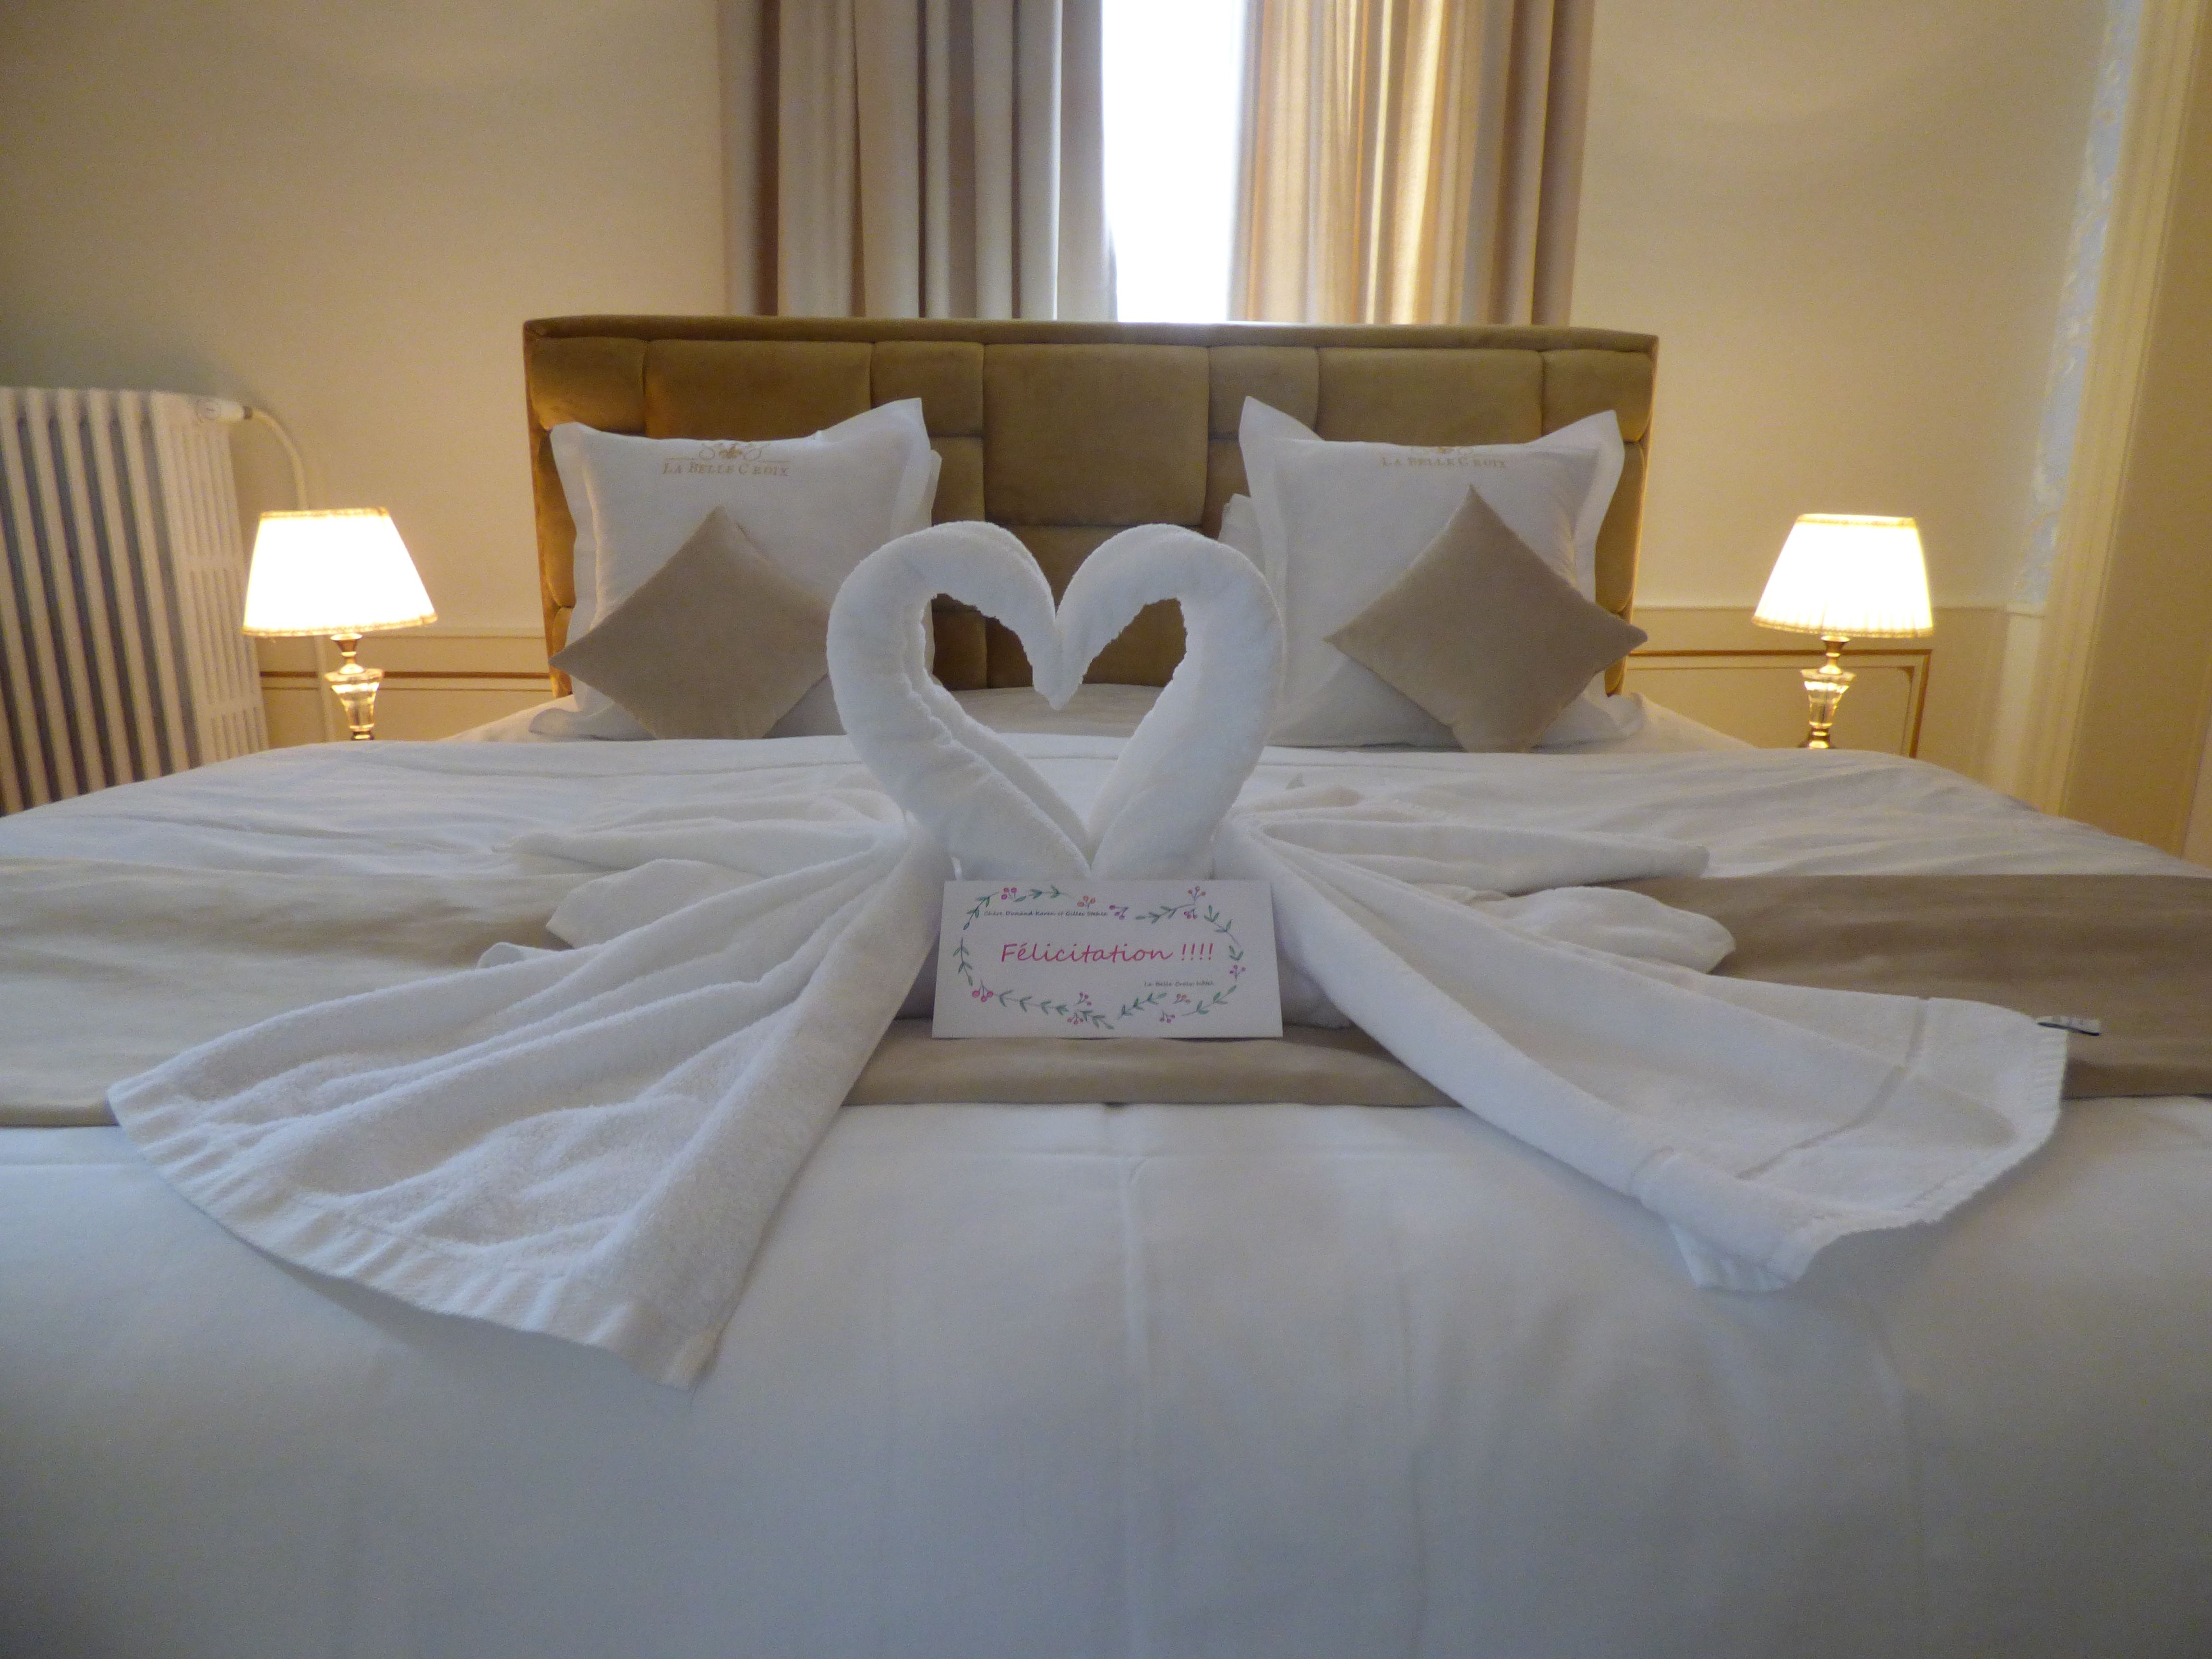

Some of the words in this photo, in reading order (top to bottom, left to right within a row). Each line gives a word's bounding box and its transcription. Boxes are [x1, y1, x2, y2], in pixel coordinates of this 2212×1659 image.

[662, 462, 682, 474] LA
[687, 461, 735, 474] BELLE
[738, 463, 790, 477] CROIX
[1381, 457, 1402, 467] LA
[1000, 942, 1174, 963] Félicitation
[1181, 942, 1214, 961] !!!!
